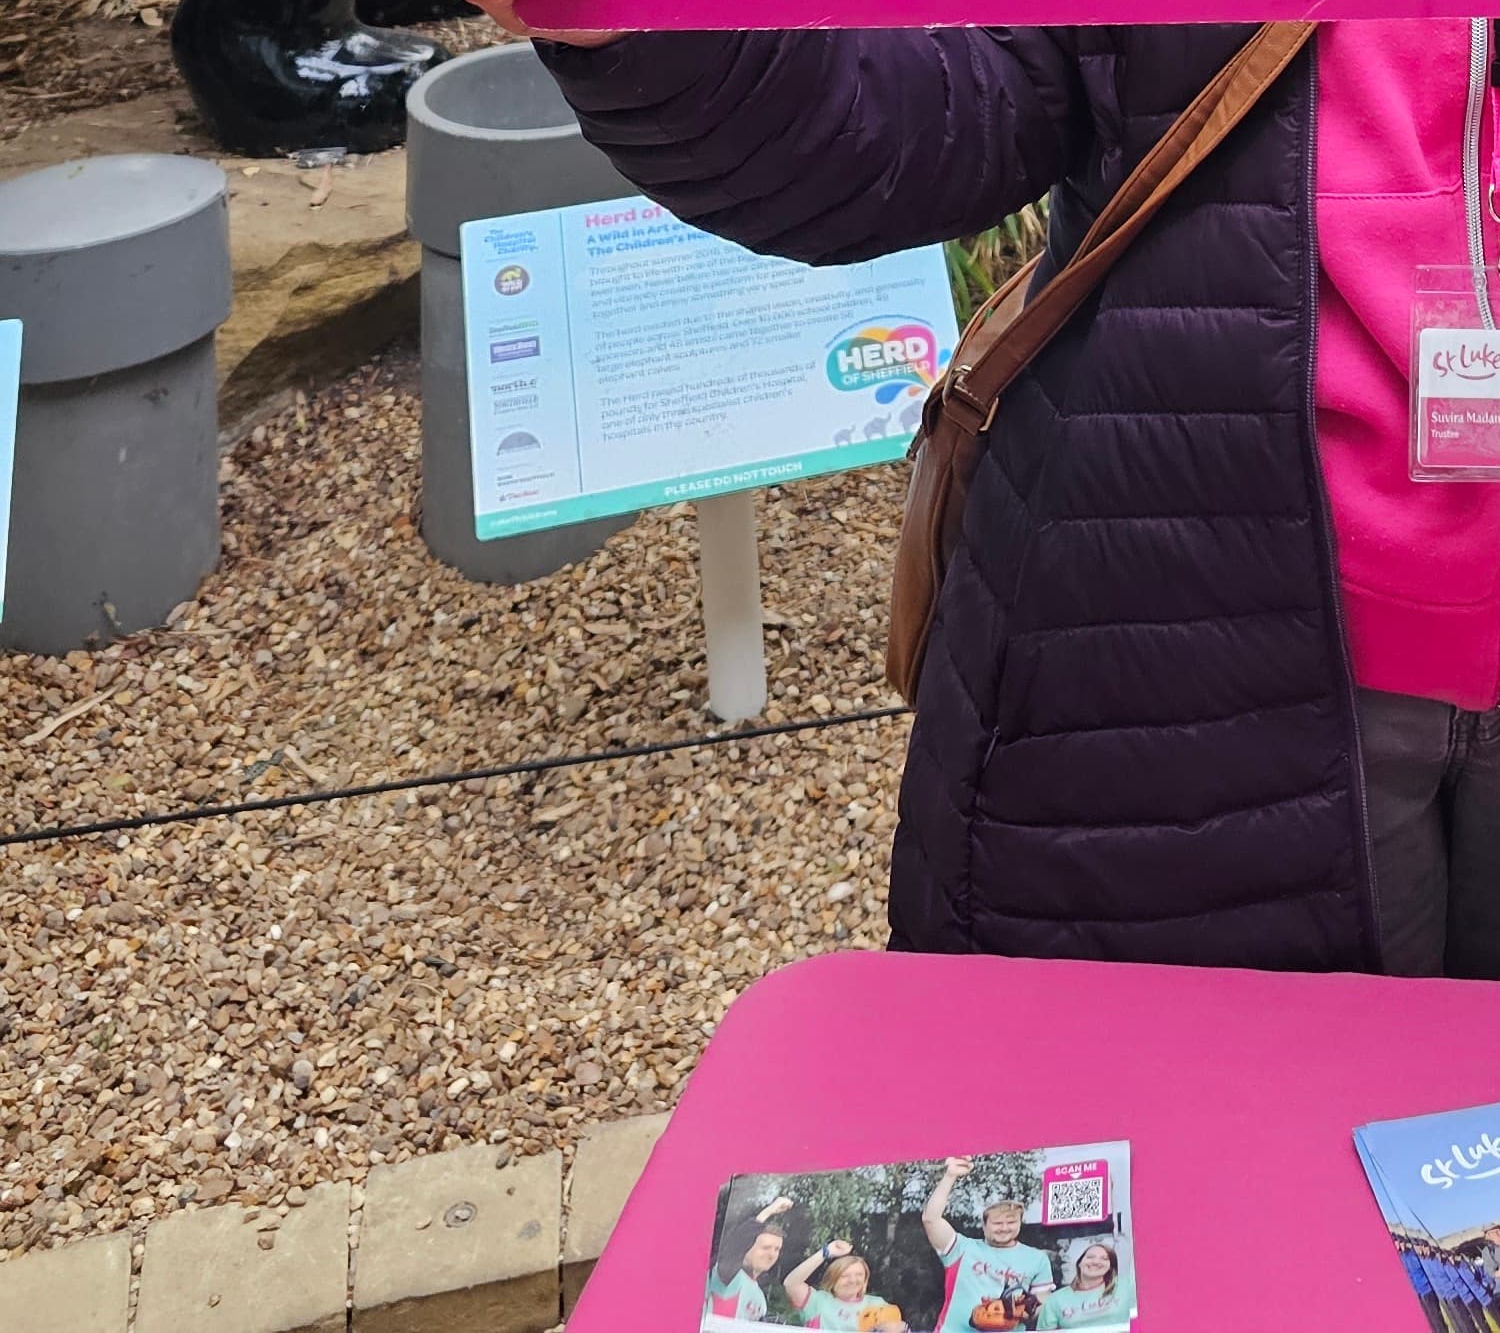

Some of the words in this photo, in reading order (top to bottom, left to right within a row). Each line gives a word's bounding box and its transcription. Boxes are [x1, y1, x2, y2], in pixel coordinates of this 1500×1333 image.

[837, 336, 929, 373] HERD
[843, 371, 860, 386] OF
[861, 360, 931, 382] SHEFFIELD
[1430, 411, 1464, 424] Suvira
[1466, 412, 1500, 425] Madan
[664, 477, 713, 497] PLEASE
[714, 475, 732, 487] DO
[733, 470, 758, 484] NOT
[758, 461, 803, 479] TOUCH
[1055, 1164, 1082, 1176] SCAN
[1083, 1162, 1097, 1172] ME
